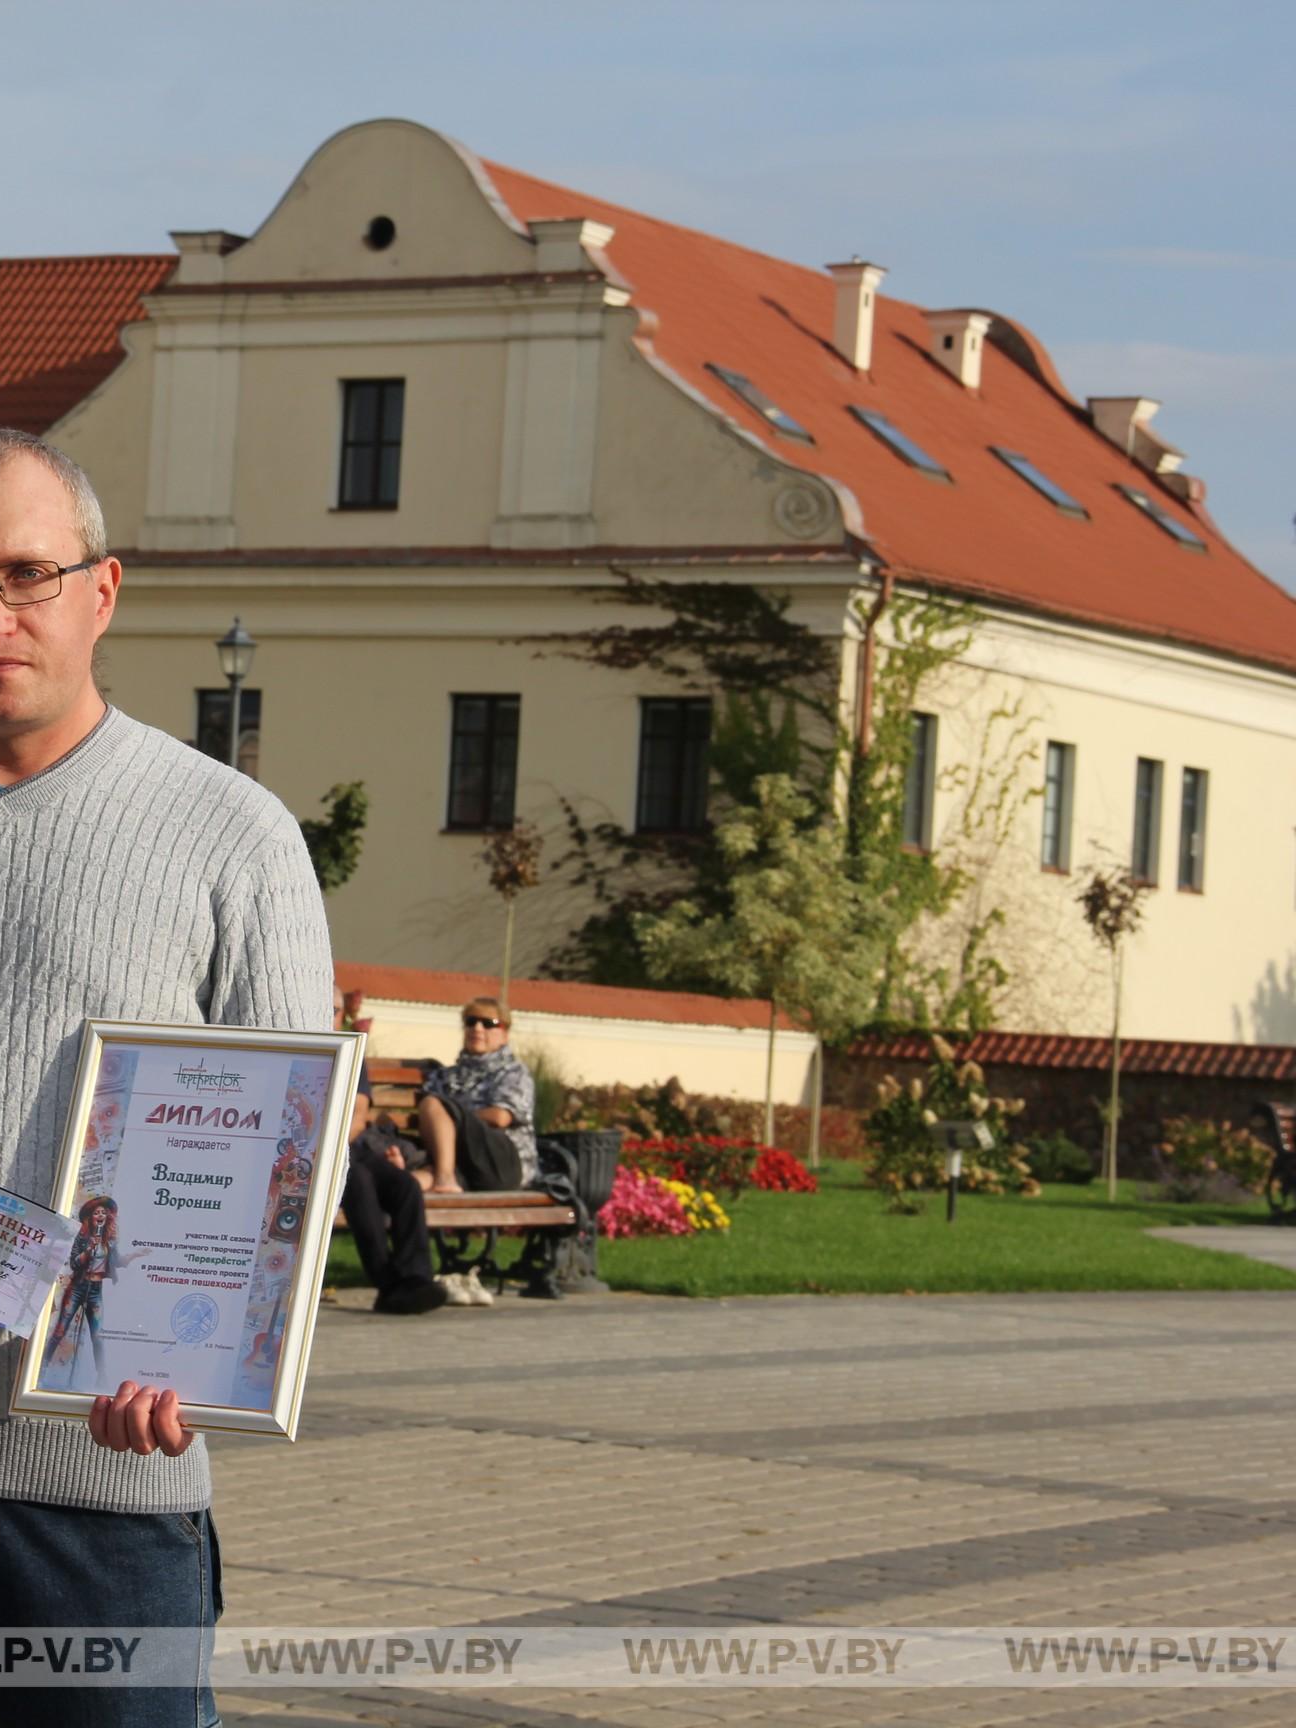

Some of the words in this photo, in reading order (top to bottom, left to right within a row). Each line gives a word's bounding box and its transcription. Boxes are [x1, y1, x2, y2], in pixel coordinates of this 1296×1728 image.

[144, 1104, 263, 1130] ДИПЛОМ
[166, 1136, 231, 1151] Награждается
[151, 1163, 233, 1189] Владимир
[153, 1187, 222, 1210] Воронин
[185, 1232, 219, 1241] участник
[132, 1240, 173, 1248] фестиваля
[174, 1243, 209, 1251] уличного
[211, 1246, 254, 1255] творчества
[148, 1265, 174, 1273] рамках
[175, 1267, 218, 1276] городского
[219, 1271, 249, 1279] проекта
